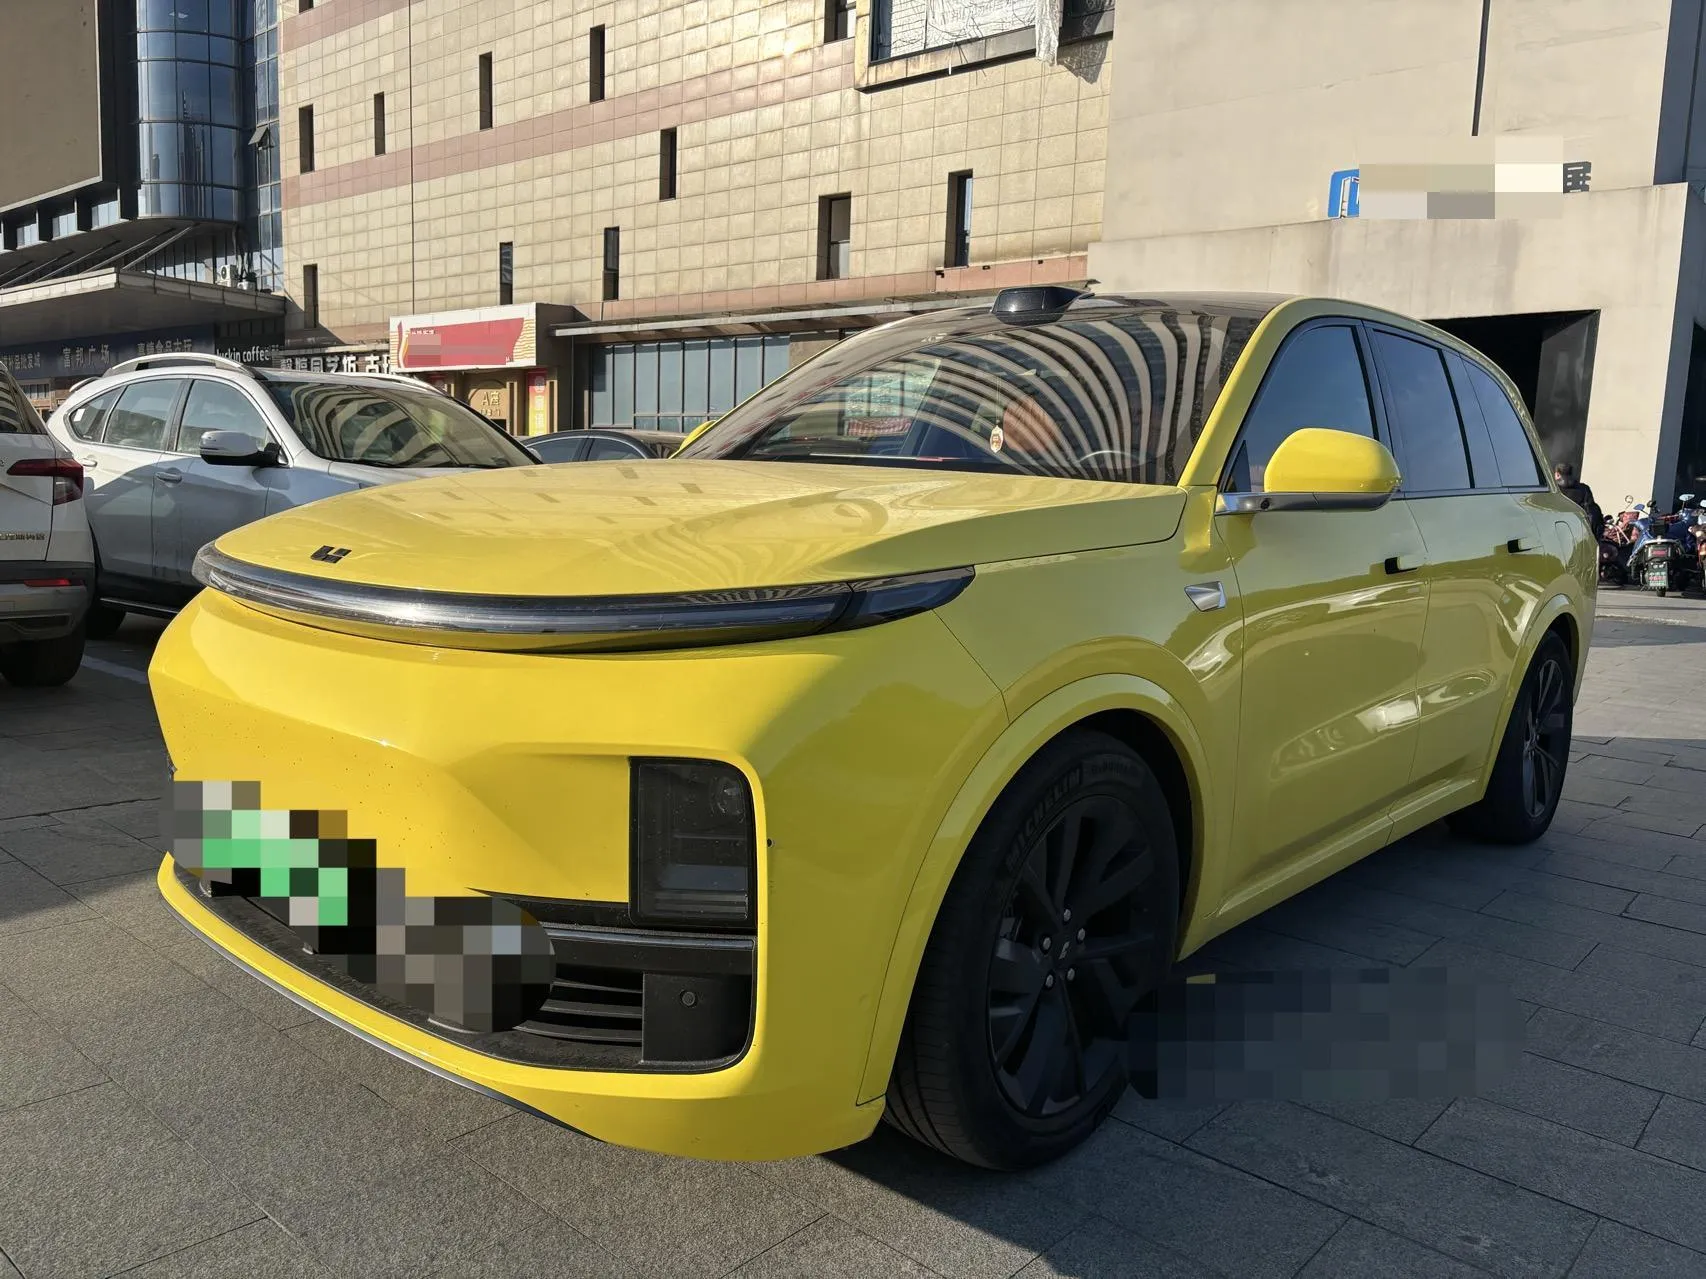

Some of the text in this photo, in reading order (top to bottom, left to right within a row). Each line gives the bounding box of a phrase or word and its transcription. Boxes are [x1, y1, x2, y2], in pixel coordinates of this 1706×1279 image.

[62, 344, 110, 369] 富邦广场
[242, 351, 270, 368] coffee
[1005, 767, 1081, 874] MICHELIN
